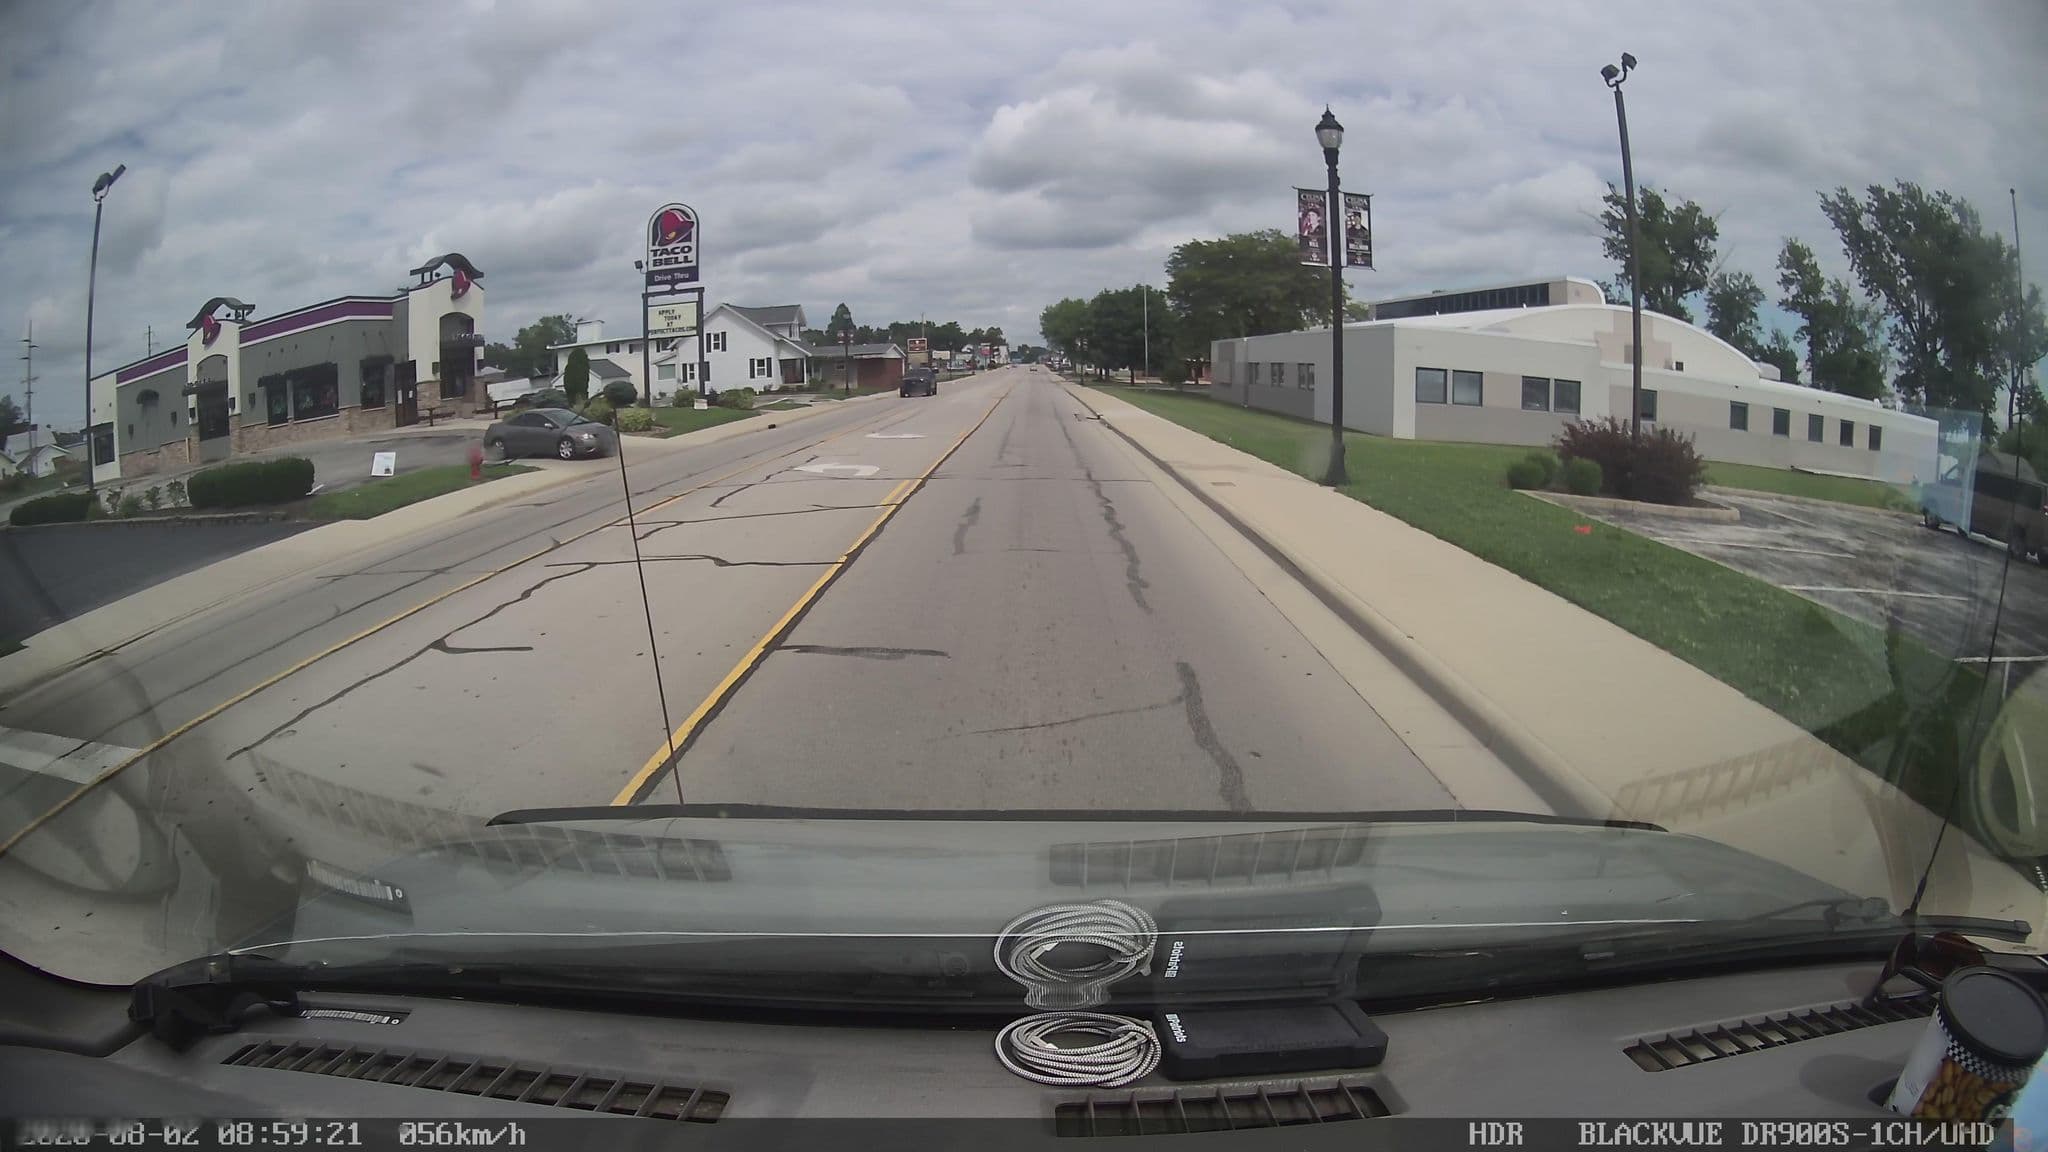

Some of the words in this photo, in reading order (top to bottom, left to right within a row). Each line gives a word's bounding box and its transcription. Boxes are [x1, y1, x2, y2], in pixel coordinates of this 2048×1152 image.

[650, 246, 692, 257] TACO
[653, 255, 693, 267] BELL
[654, 274, 672, 282] Drive
[674, 272, 689, 280] Thru
